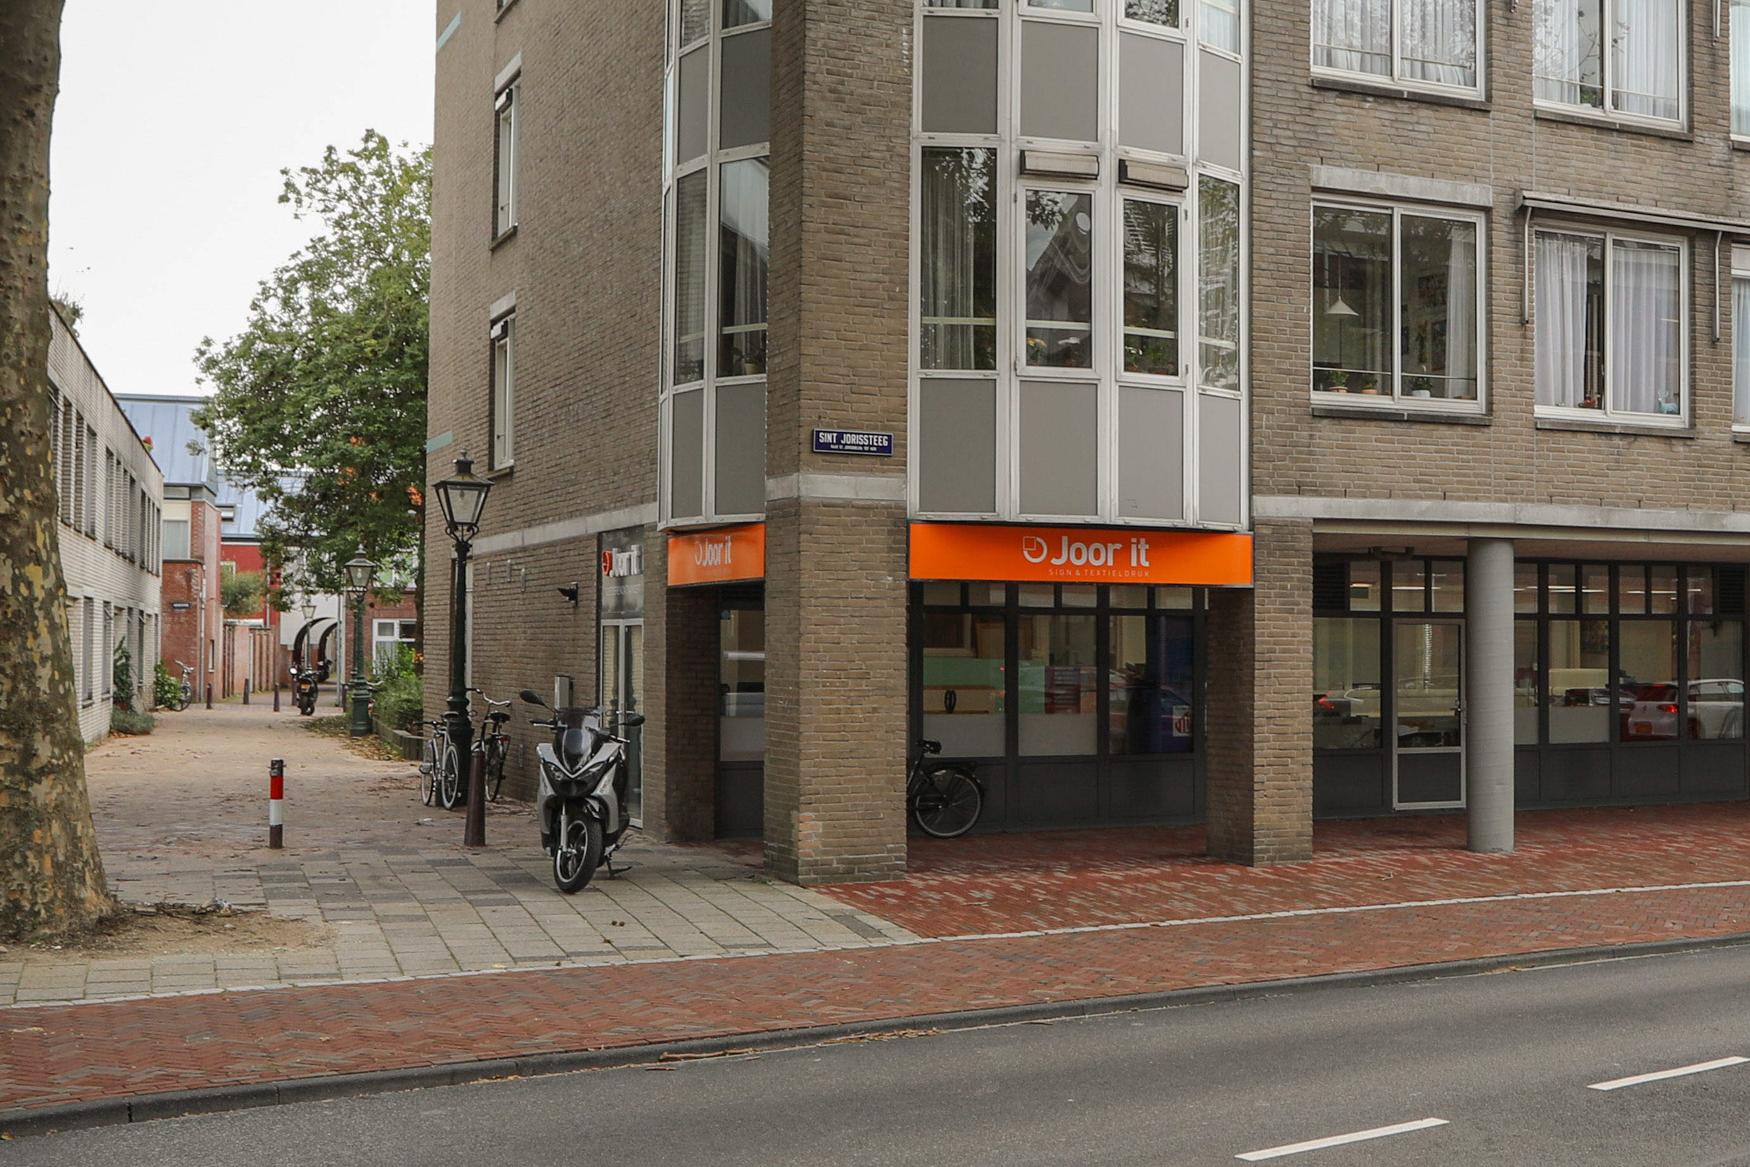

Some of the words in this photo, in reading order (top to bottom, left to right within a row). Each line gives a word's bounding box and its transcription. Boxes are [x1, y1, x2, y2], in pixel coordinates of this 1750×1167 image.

[819, 432, 838, 444] SINT
[840, 433, 889, 447] JORISSTEEG
[702, 537, 723, 567] Joor
[724, 535, 733, 565] it
[1050, 535, 1123, 567] Joor
[1130, 537, 1150, 567] it
[1048, 568, 1072, 576] SIGN
[1075, 569, 1081, 577] &
[1084, 569, 1150, 578] TEXTIELDRUK
